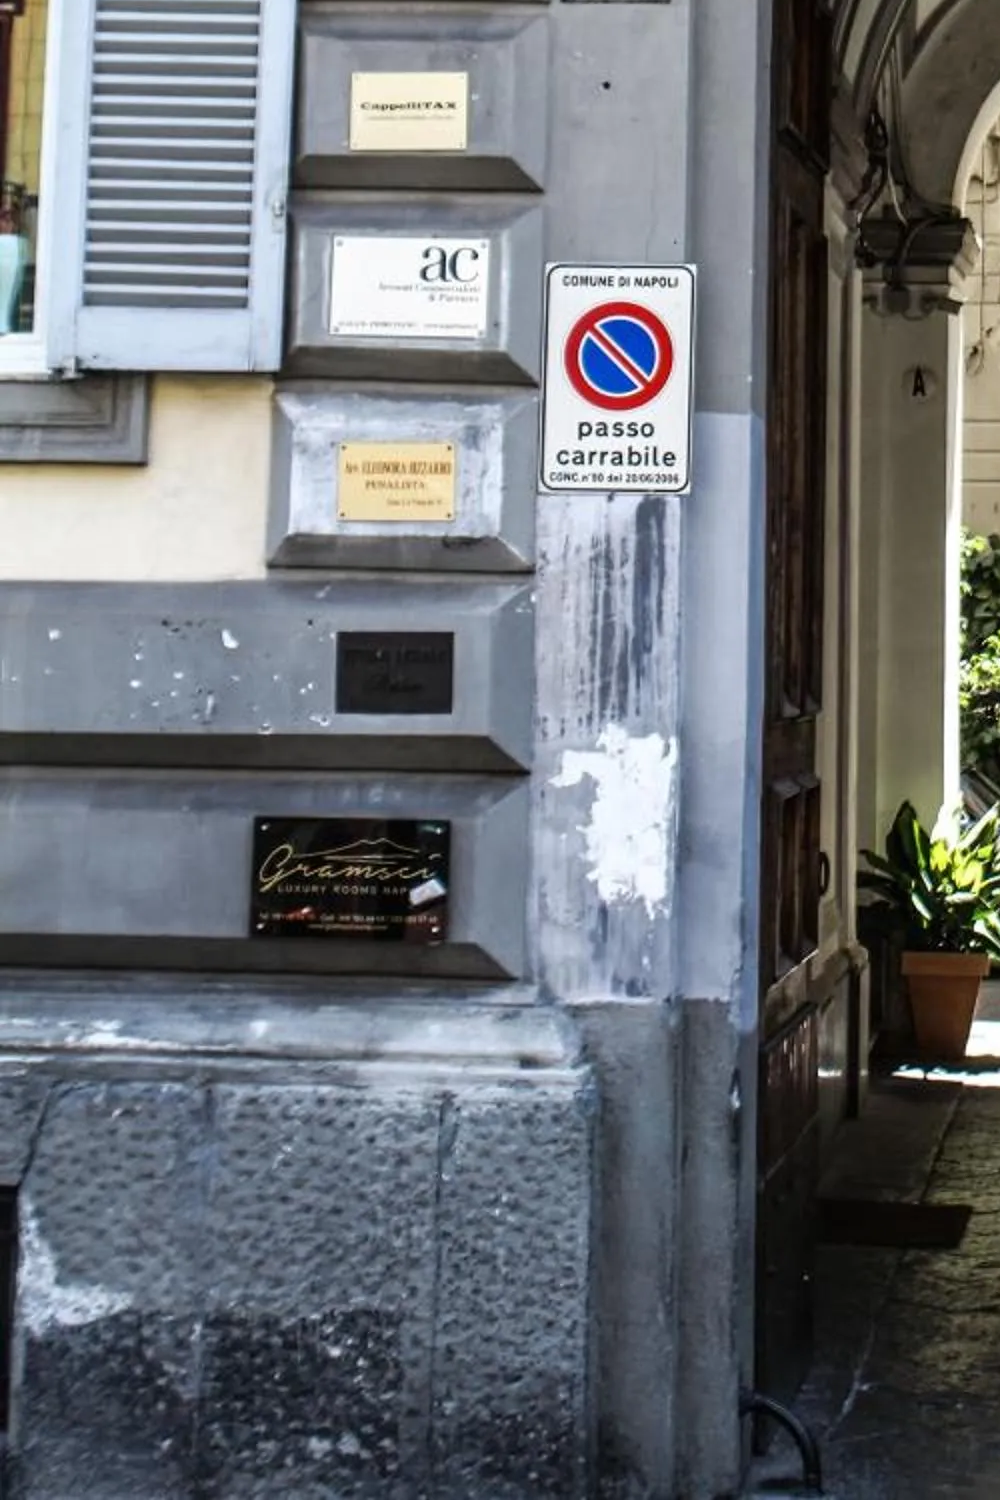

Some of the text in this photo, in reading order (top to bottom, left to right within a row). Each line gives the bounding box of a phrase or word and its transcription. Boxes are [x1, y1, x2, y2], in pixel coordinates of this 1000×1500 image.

[420, 245, 479, 283] ac
[563, 275, 679, 288] COMUNE DI NAPOLI
[912, 365, 927, 397] A
[578, 421, 655, 441] passo
[556, 445, 677, 467] carrabile
[259, 844, 442, 893] Gramsci
[278, 884, 326, 894] LUXURY
